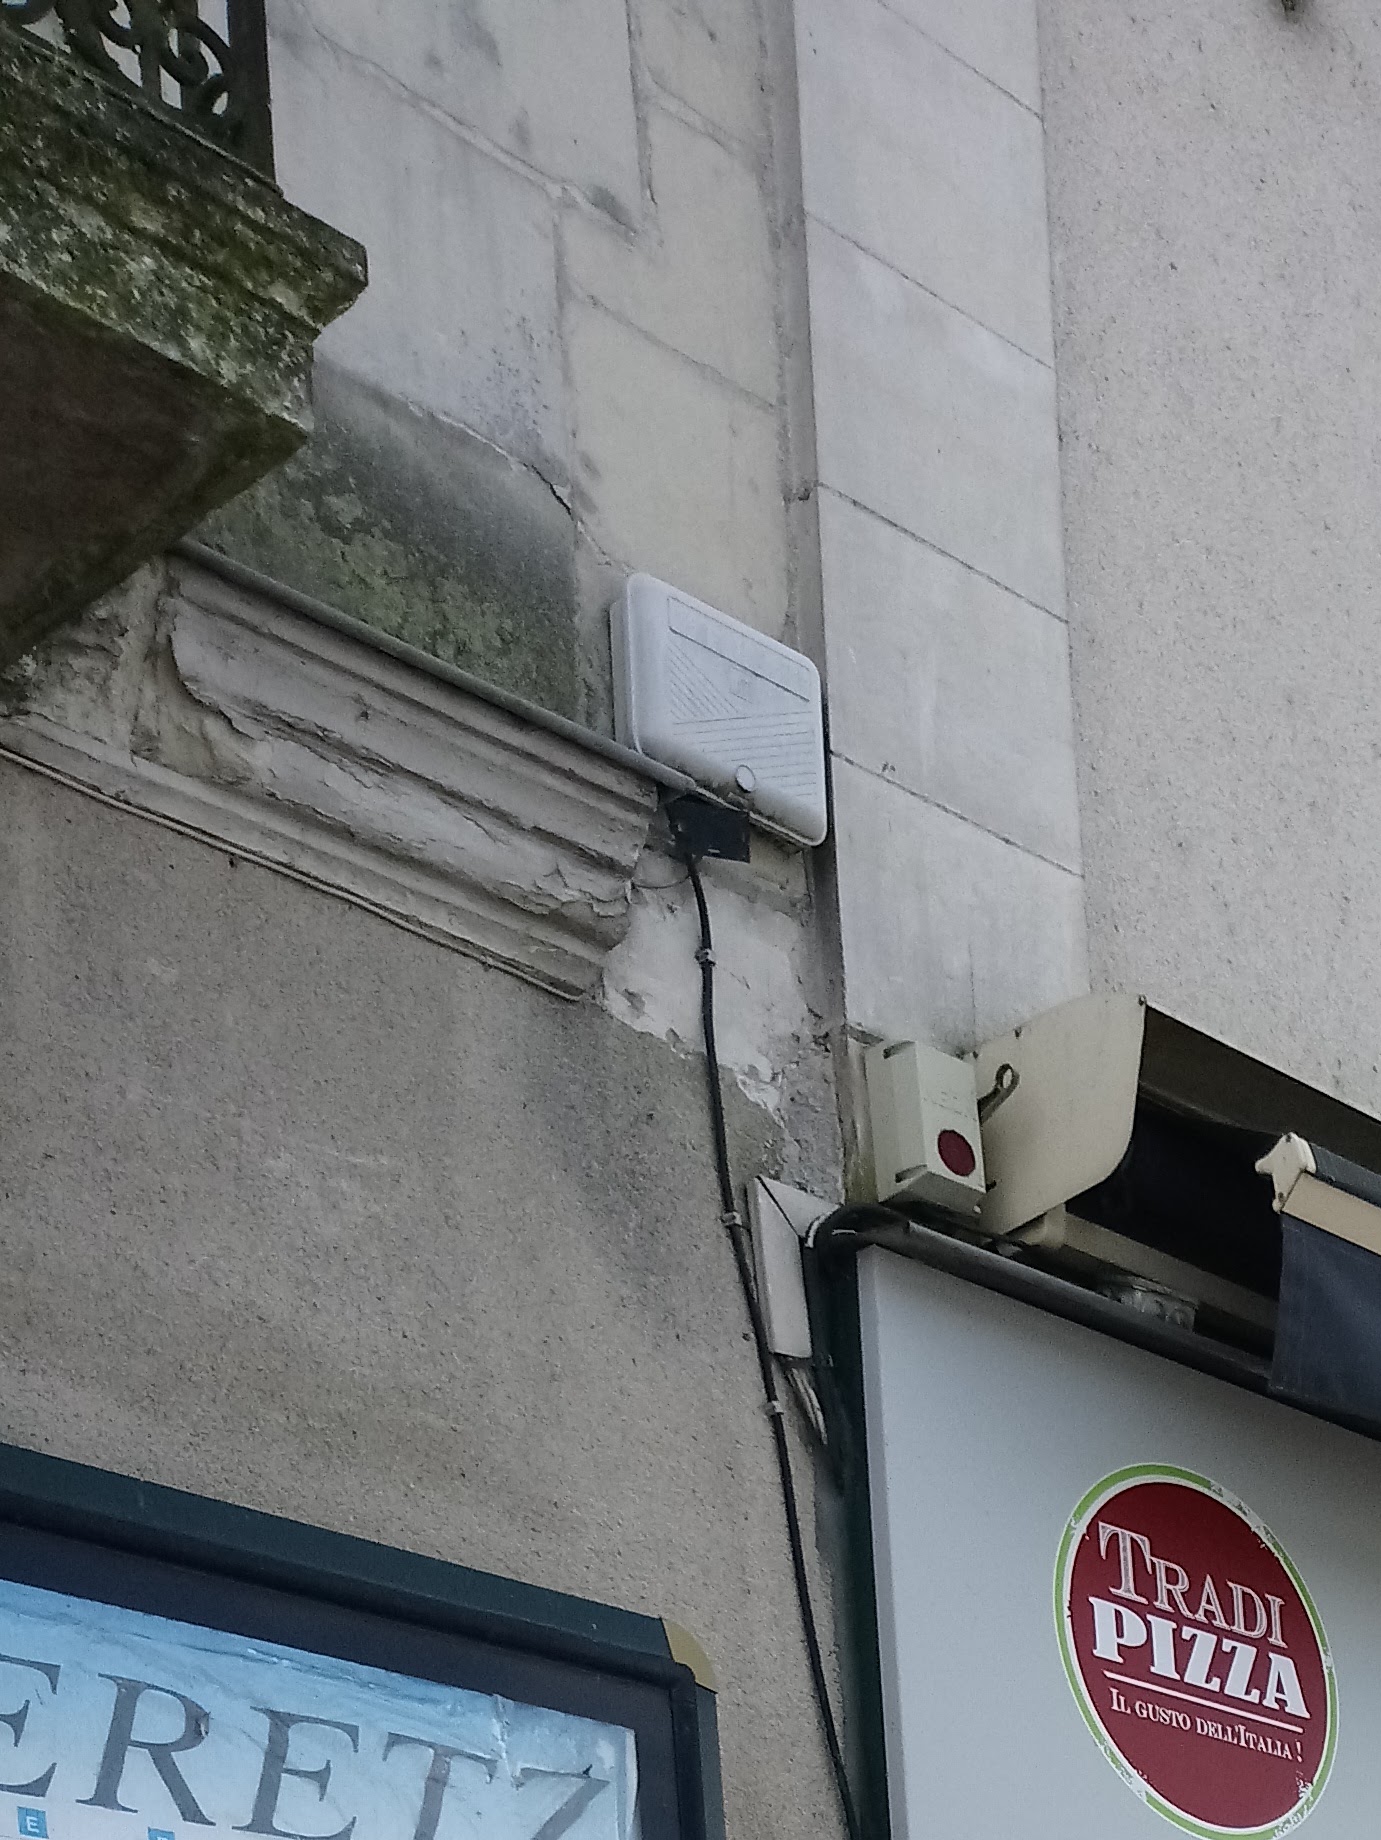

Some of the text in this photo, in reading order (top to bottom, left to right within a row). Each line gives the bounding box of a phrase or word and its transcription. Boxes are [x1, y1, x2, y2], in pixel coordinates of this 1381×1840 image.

[1098, 1521, 1288, 1648] TRADI
[1089, 1597, 1310, 1719] PIZZA
[1135, 1700, 1191, 1730] GUSTO
